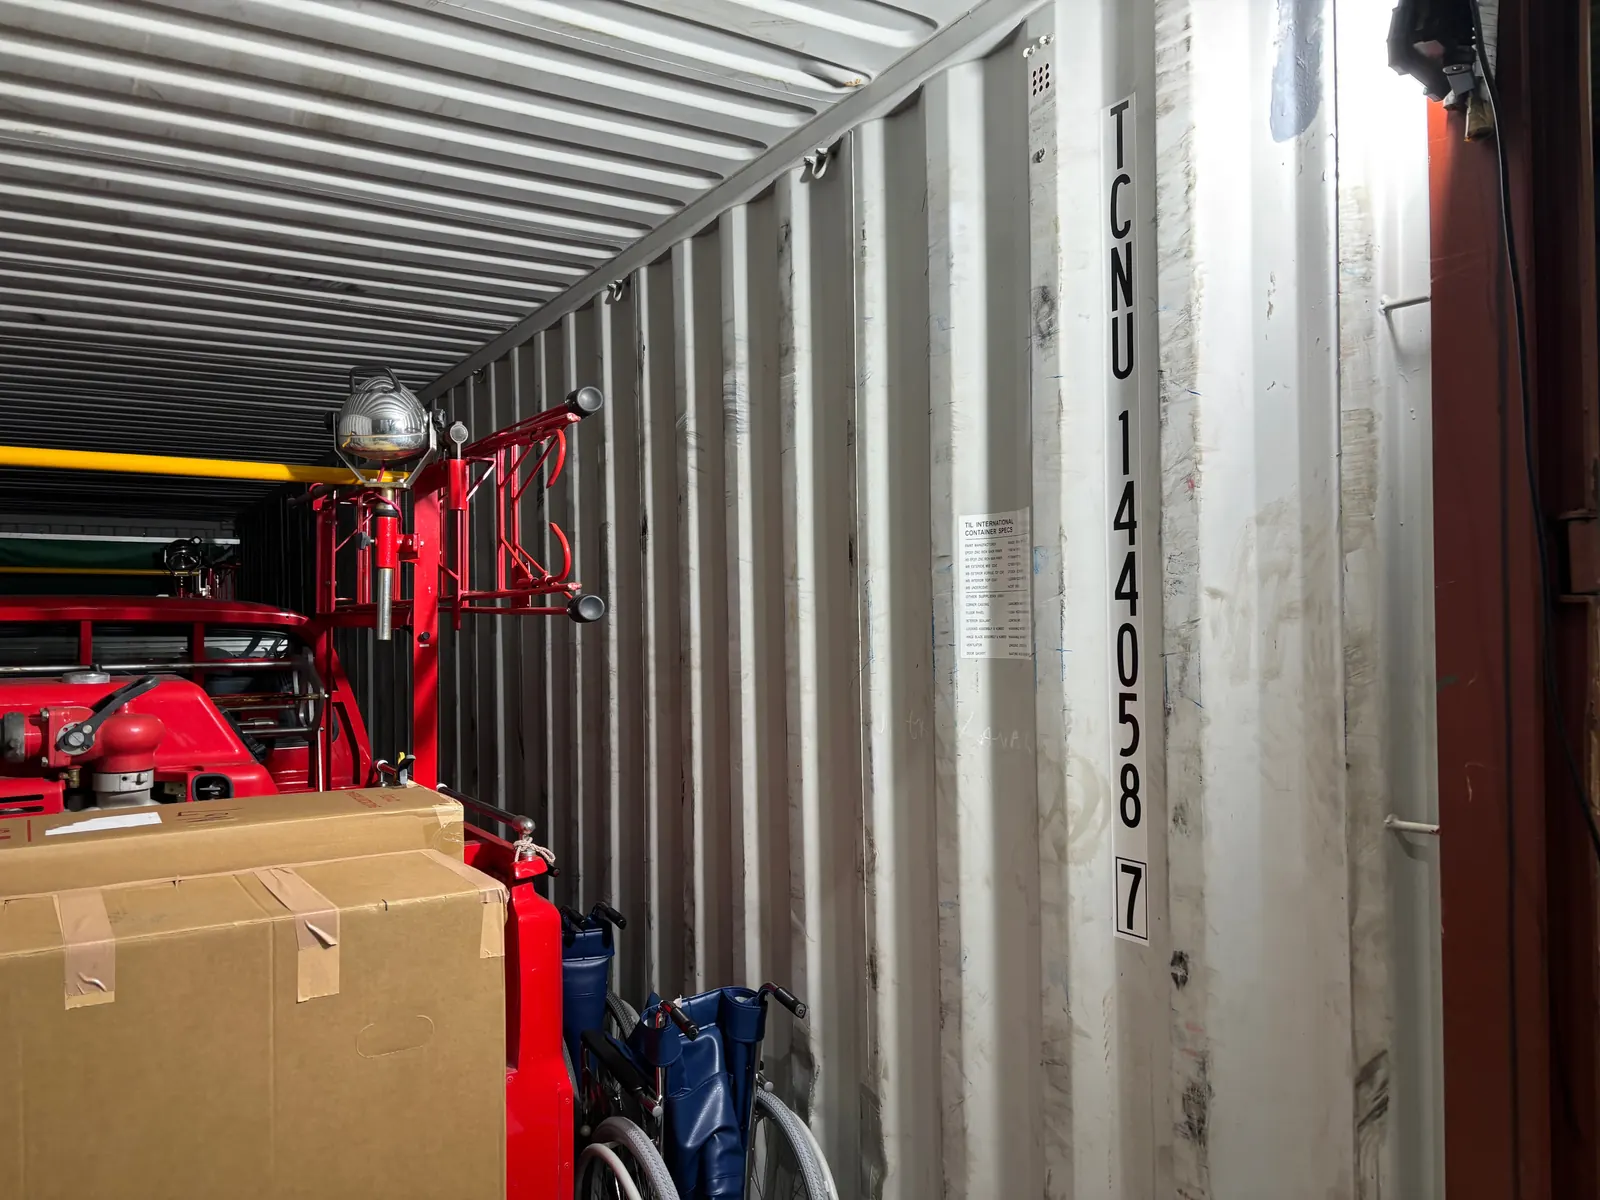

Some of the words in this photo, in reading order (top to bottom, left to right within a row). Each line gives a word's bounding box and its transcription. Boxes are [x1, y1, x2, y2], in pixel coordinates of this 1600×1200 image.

[1110, 99, 1134, 380] TCNU
[965, 528, 997, 536] CONTAINER
[998, 526, 1013, 534] SPECS
[976, 518, 1014, 527] INTERNATIONAL
[1113, 409, 1141, 829] 144058
[1120, 863, 1142, 931] 7
